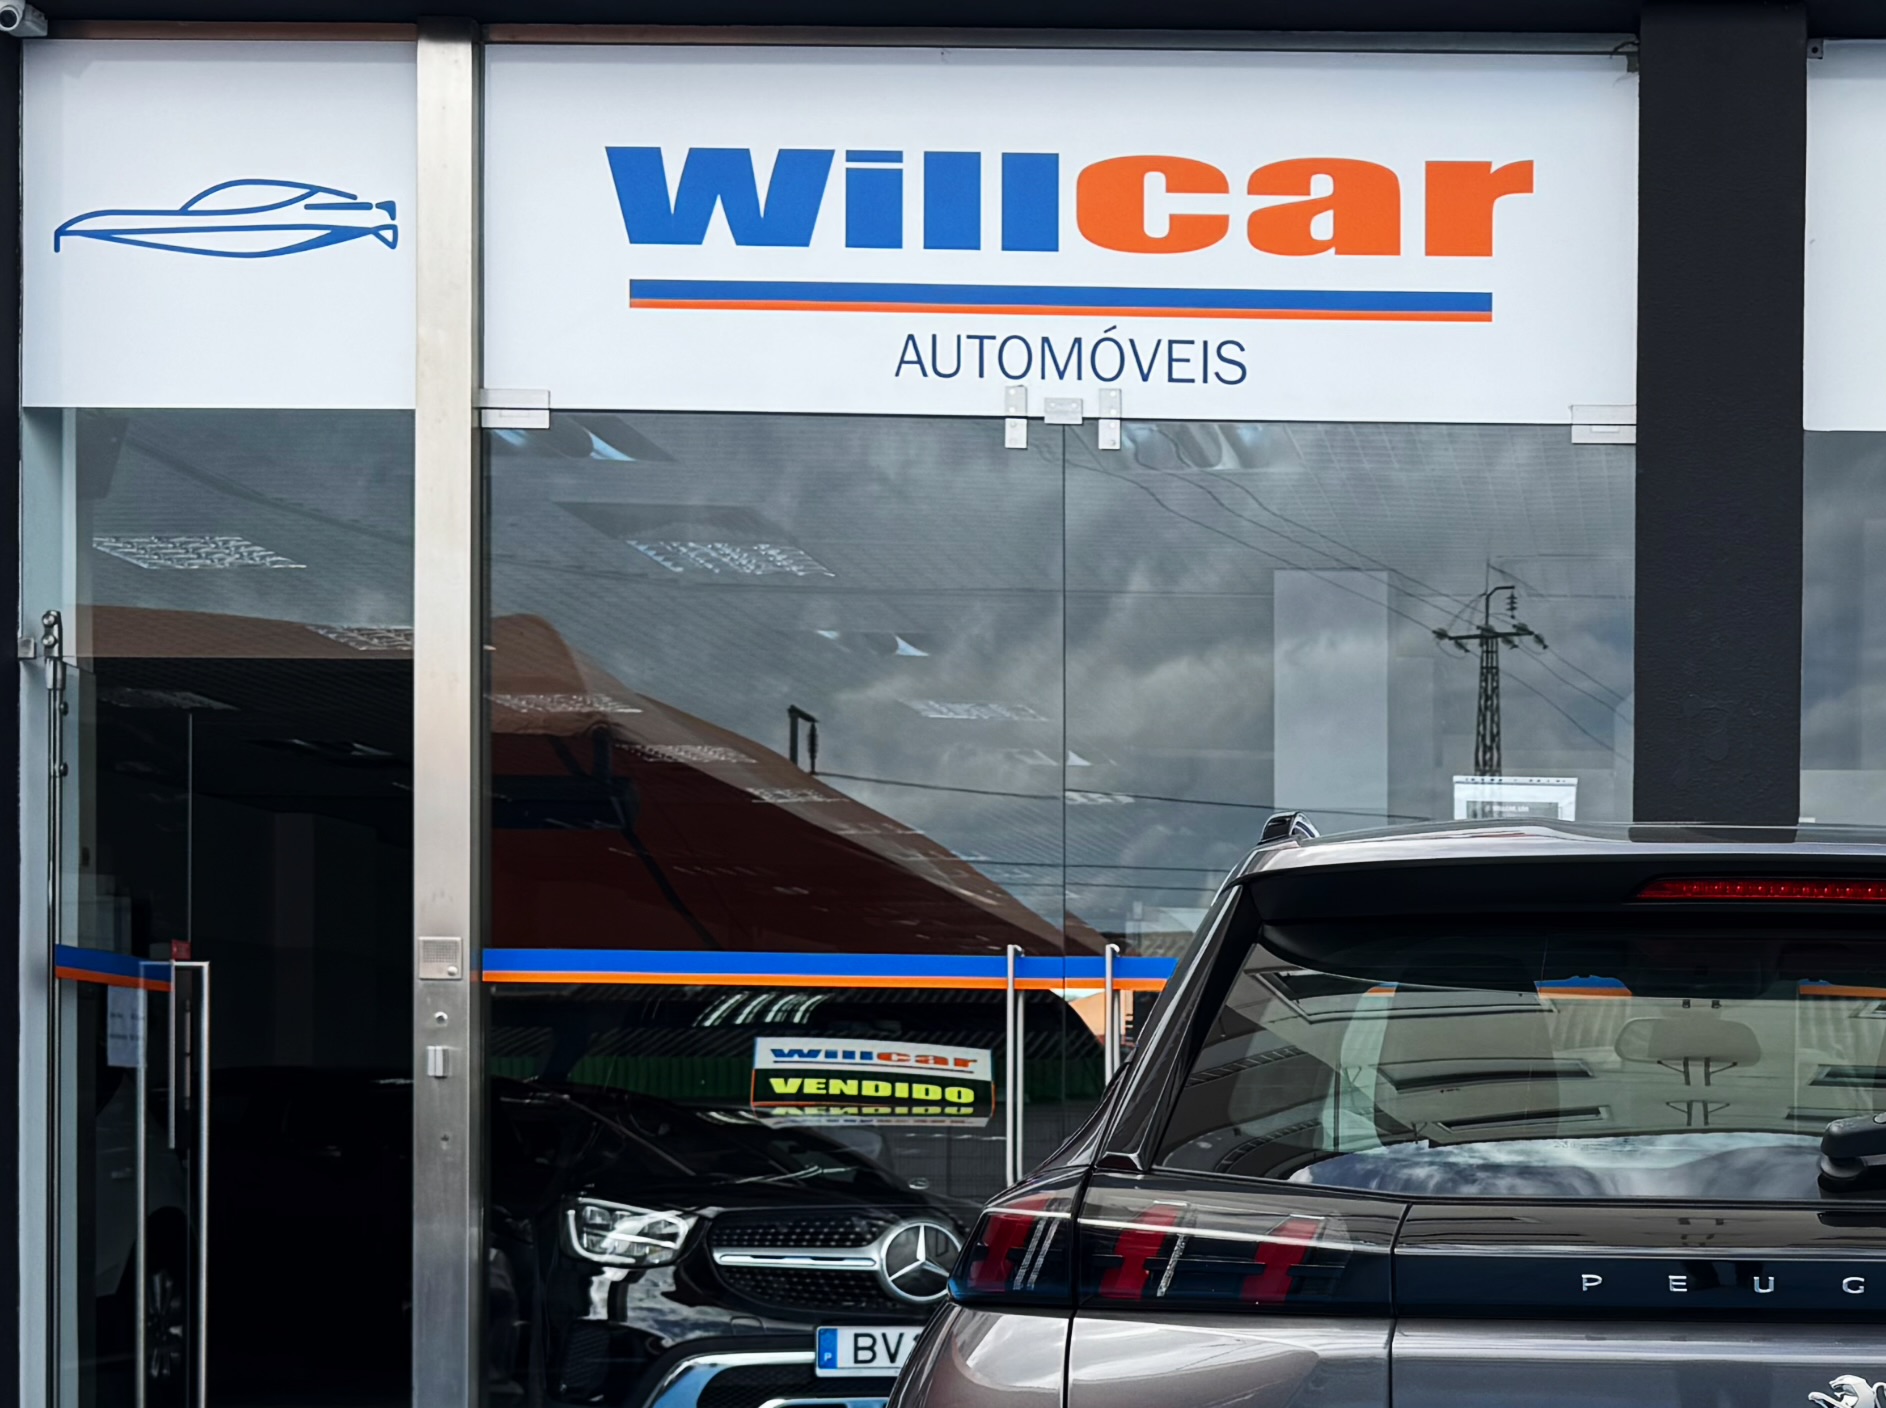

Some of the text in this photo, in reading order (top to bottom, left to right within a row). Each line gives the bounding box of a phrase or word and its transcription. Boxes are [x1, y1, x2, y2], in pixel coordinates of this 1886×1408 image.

[605, 146, 1534, 257] willcar
[895, 323, 1247, 385] AUTOMÓVEIS
[770, 1049, 978, 1068] willcar
[769, 1078, 975, 1103] VENDIDO
[853, 1332, 922, 1364] BV
